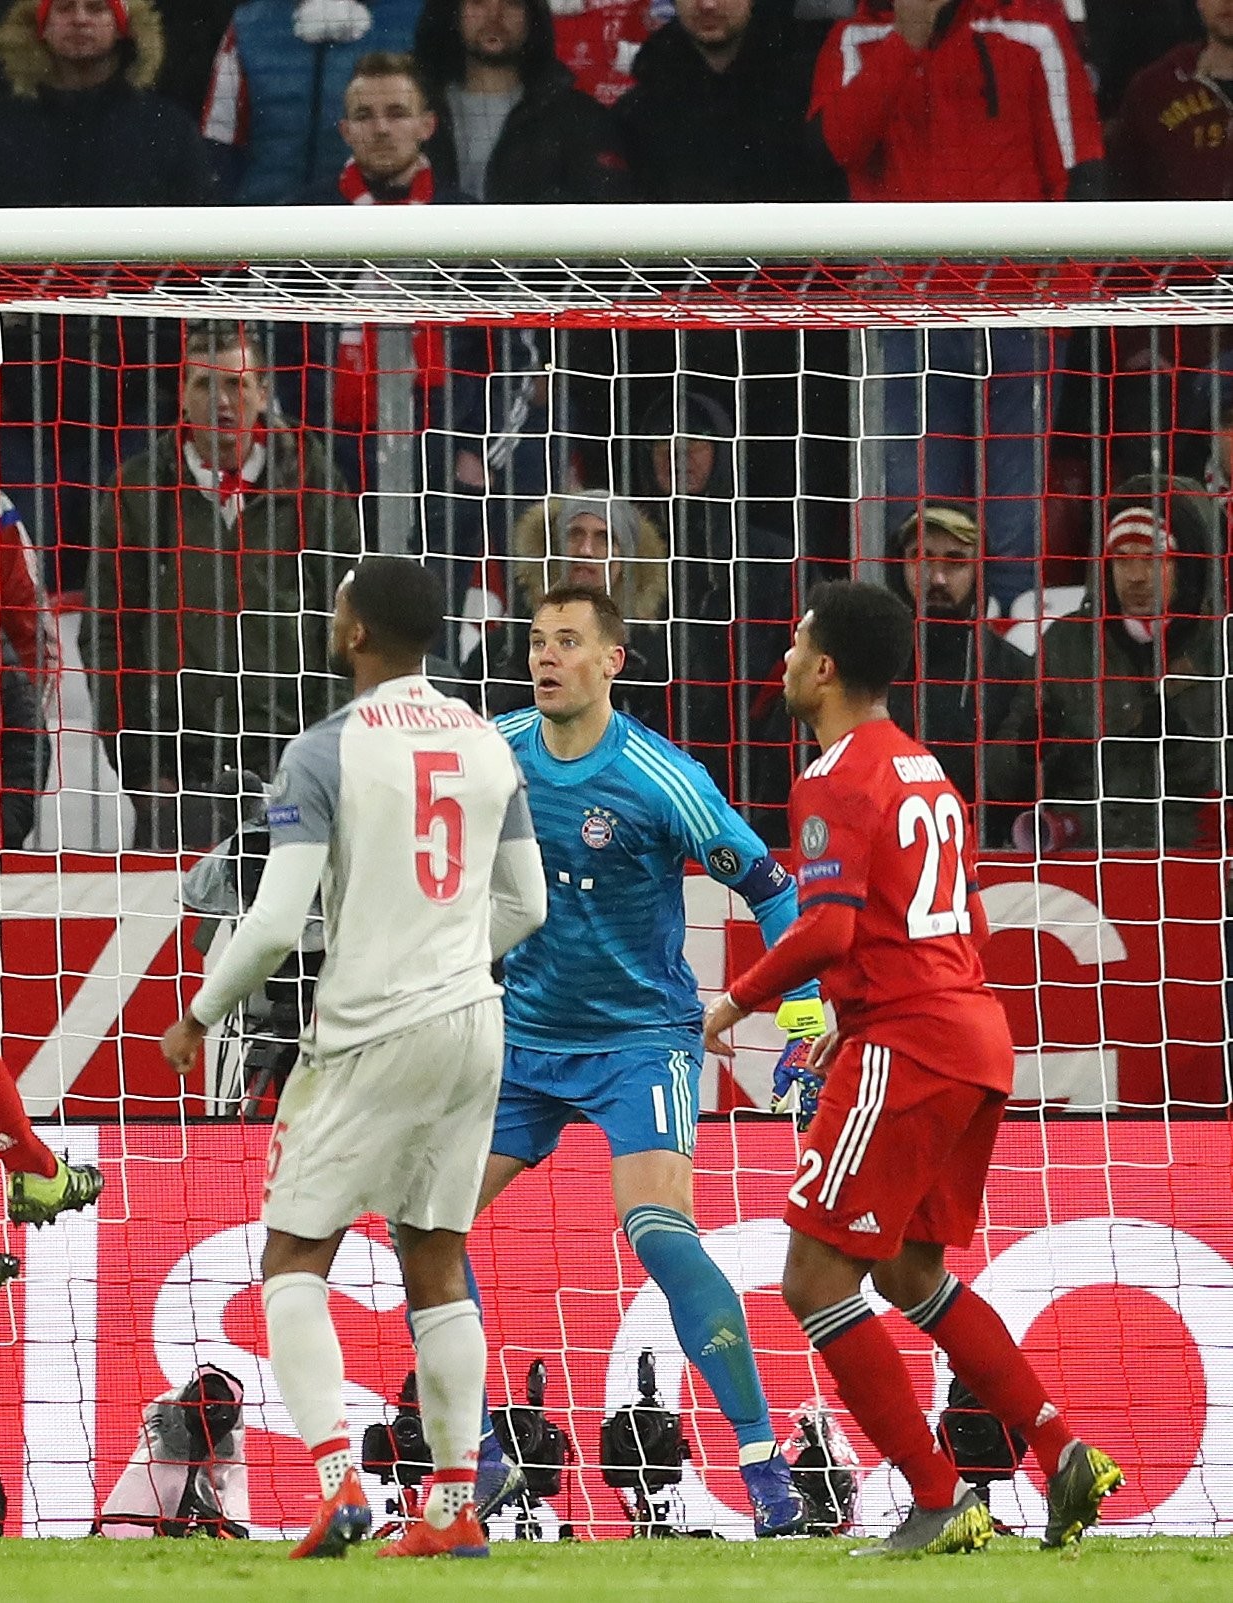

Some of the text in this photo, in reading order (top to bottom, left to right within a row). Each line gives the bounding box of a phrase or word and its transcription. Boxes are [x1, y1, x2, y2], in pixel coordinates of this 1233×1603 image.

[412, 750, 465, 904] 5
[898, 792, 972, 940] 22
[652, 1085, 668, 1133] 1
[788, 1149, 823, 1209] 2
